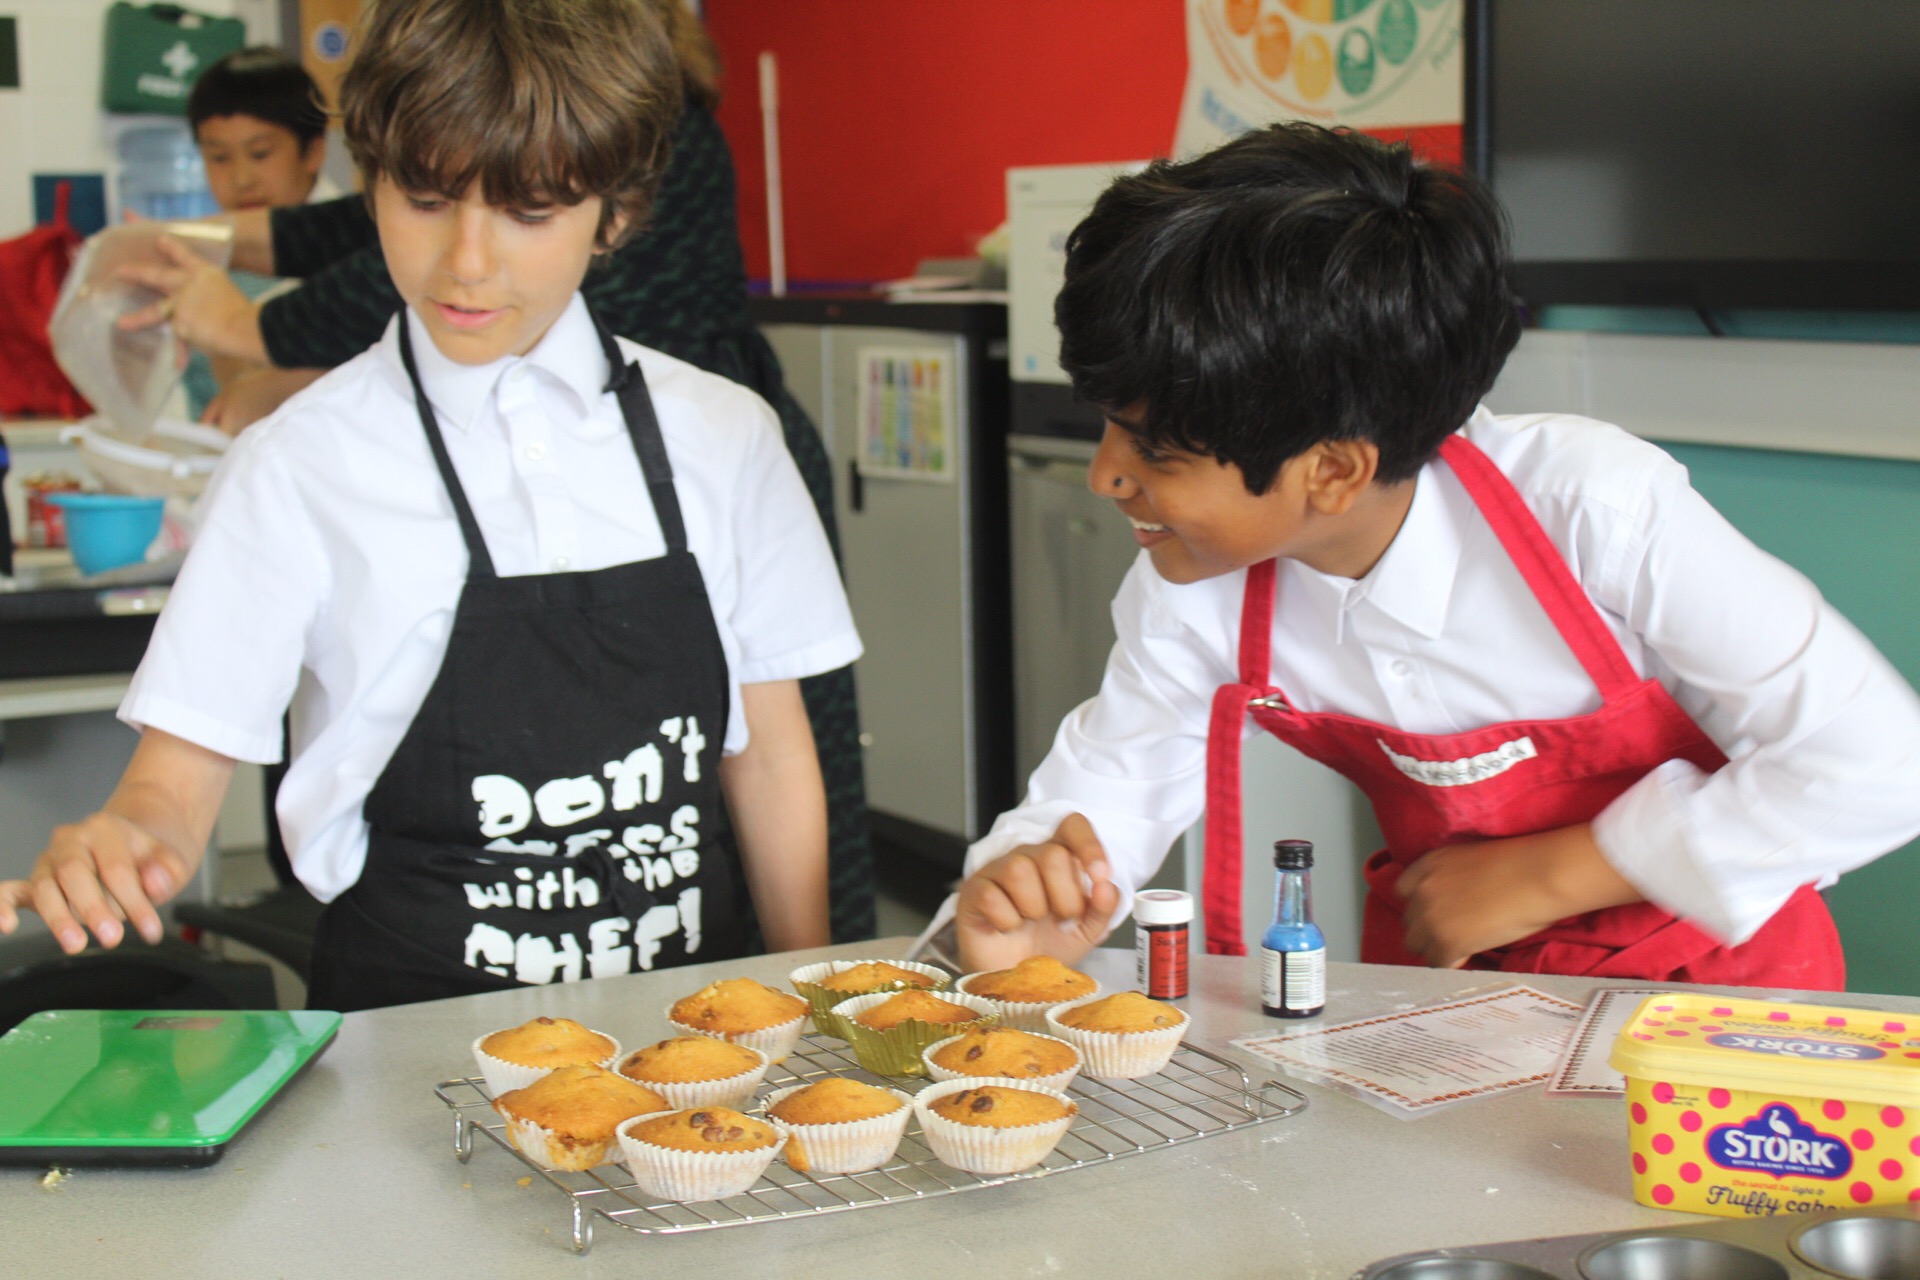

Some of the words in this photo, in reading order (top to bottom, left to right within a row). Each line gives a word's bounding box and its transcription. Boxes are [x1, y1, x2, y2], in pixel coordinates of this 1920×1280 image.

[471, 715, 706, 838] Don't
[462, 866, 600, 910] with
[622, 848, 700, 892] the
[1726, 1036, 1862, 1058] STORK
[1723, 1128, 1836, 1169] STORK
[1706, 1185, 1780, 1217] Fluffy
